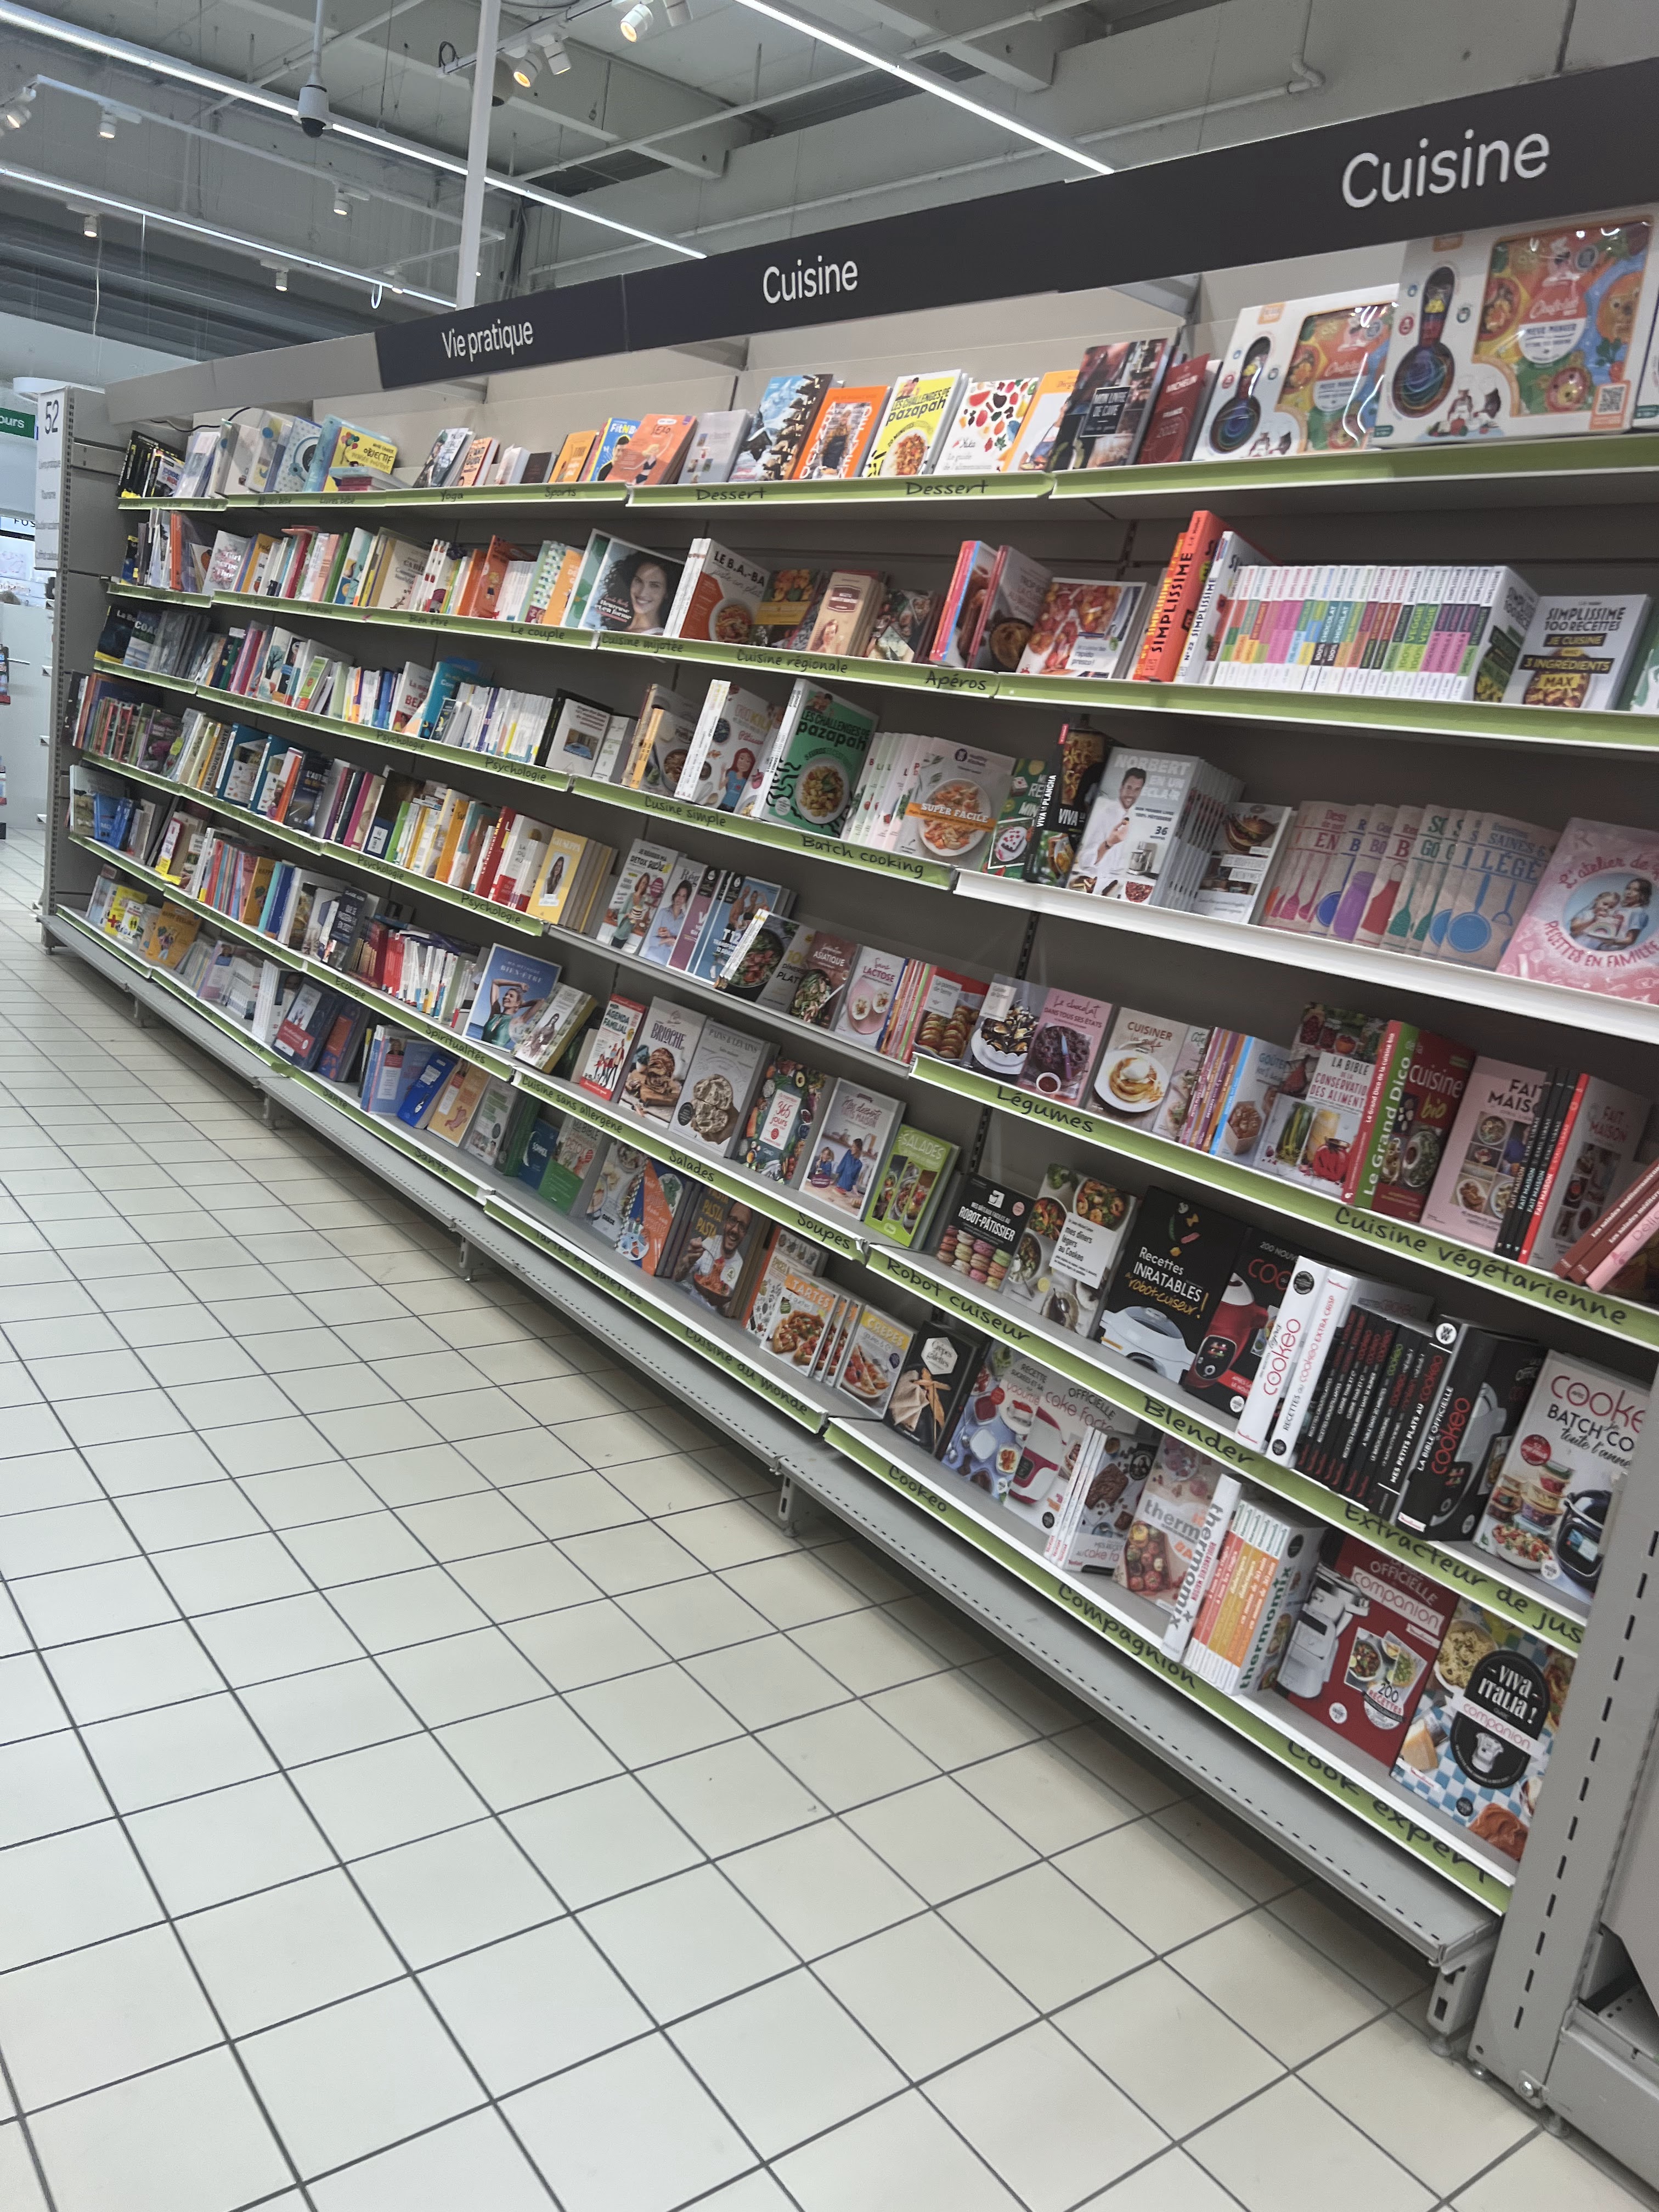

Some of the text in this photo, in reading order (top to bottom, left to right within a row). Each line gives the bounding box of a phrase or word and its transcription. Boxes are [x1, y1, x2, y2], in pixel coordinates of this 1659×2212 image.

[1342, 129, 1550, 208] Cuisine
[763, 256, 859, 304] Cuisine
[442, 319, 534, 362] Vie pratique
[45, 400, 59, 434] 52
[887, 395, 946, 426] pazapah
[441, 491, 464, 503] Yoga
[696, 487, 766, 501] Dessert
[905, 479, 989, 495] Dessert
[713, 551, 727, 563] LE
[1151, 552, 1192, 652] SIMPLISSIME
[1546, 606, 1627, 621] SIMPLISSIME
[511, 625, 566, 641] Le couple
[1544, 620, 1620, 632] 100 RECETTES
[737, 648, 848, 674] Cuisine régionale
[1523, 658, 1532, 668] 3
[926, 670, 987, 691] Apéros
[1542, 676, 1573, 689] MAX
[376, 731, 426, 751] Psychologie
[796, 720, 868, 752] pazapah
[484, 758, 546, 783] Psychologie
[1114, 754, 1191, 775] NORBERT
[921, 803, 989, 823] SUPER FACILE
[1036, 810, 1047, 827] VIVA
[1043, 775, 1057, 806] PLANCHA
[1154, 826, 1167, 836] 36
[1314, 832, 1340, 850] EN
[357, 855, 404, 881] Psychologie
[802, 834, 924, 879] Batch cooking
[461, 893, 521, 924] Psychologie
[862, 965, 896, 983] LACTOSE
[1584, 953, 1601, 967] EN
[425, 1024, 486, 1064] Spiritualités
[651, 1023, 687, 1050] BRIOCHE
[1127, 1021, 1172, 1041] CUISINER
[1331, 1056, 1370, 1076] LA BIBLE
[1409, 1063, 1464, 1098] cuisine
[521, 1074, 555, 1099] Cuisine
[555, 1093, 577, 1111] sans
[1310, 1085, 1365, 1109] DES ALIMENT
[1421, 1092, 1447, 1119] bio
[776, 1101, 792, 1119] 365
[996, 1085, 1094, 1134] Légumes
[1363, 1057, 1410, 1195] Le Grand Dico
[414, 1147, 449, 1175] Santé
[899, 1132, 945, 1160] SALADES
[669, 1149, 714, 1182] Salades
[695, 1216, 716, 1238] PASTA
[704, 1199, 723, 1222] PASTA
[957, 1206, 1016, 1242] ROBOT-PÂTISSIER
[797, 1212, 850, 1250] Soupes
[1139, 1246, 1184, 1276] Recettes
[1335, 1207, 1628, 1325] Cuisine végétarienne
[792, 1279, 836, 1308] TARTES
[886, 1256, 1031, 1340] Robot cuiseur
[1127, 1274, 1201, 1316] robot-cuiseur
[1133, 1261, 1203, 1303] INRATABLES
[685, 1326, 734, 1363] Cuisine
[760, 1375, 808, 1415] monde
[1283, 1395, 1301, 1431] RECETTES
[1314, 1318, 1328, 1343] EXTRA
[1323, 1295, 1335, 1317] CRISP
[1068, 1387, 1117, 1420] OFFICIELLE
[1143, 1395, 1255, 1464] Blender
[1406, 1415, 1419, 1438] PLATS
[1415, 1403, 1424, 1415] AU
[1417, 1386, 1454, 1471] LA BIBLE OFFICIELLE
[1431, 1398, 1470, 1474] cookeo
[1547, 1403, 1634, 1452] BATCH CO
[888, 1464, 947, 1514] Cookeo
[1144, 1499, 1203, 1541] therm
[1170, 1504, 1224, 1629] thermomix
[1344, 1501, 1584, 1645] Extracteur de jus
[1352, 1571, 1440, 1629] companion
[1370, 1561, 1438, 1606] OFFICIELLE
[1057, 1582, 1196, 1690] Compagnion
[1239, 1567, 1293, 1690] thermomix
[1377, 1683, 1400, 1703] 200
[1463, 1702, 1531, 1748] companion
[1287, 1739, 1486, 1883] Cook expert
